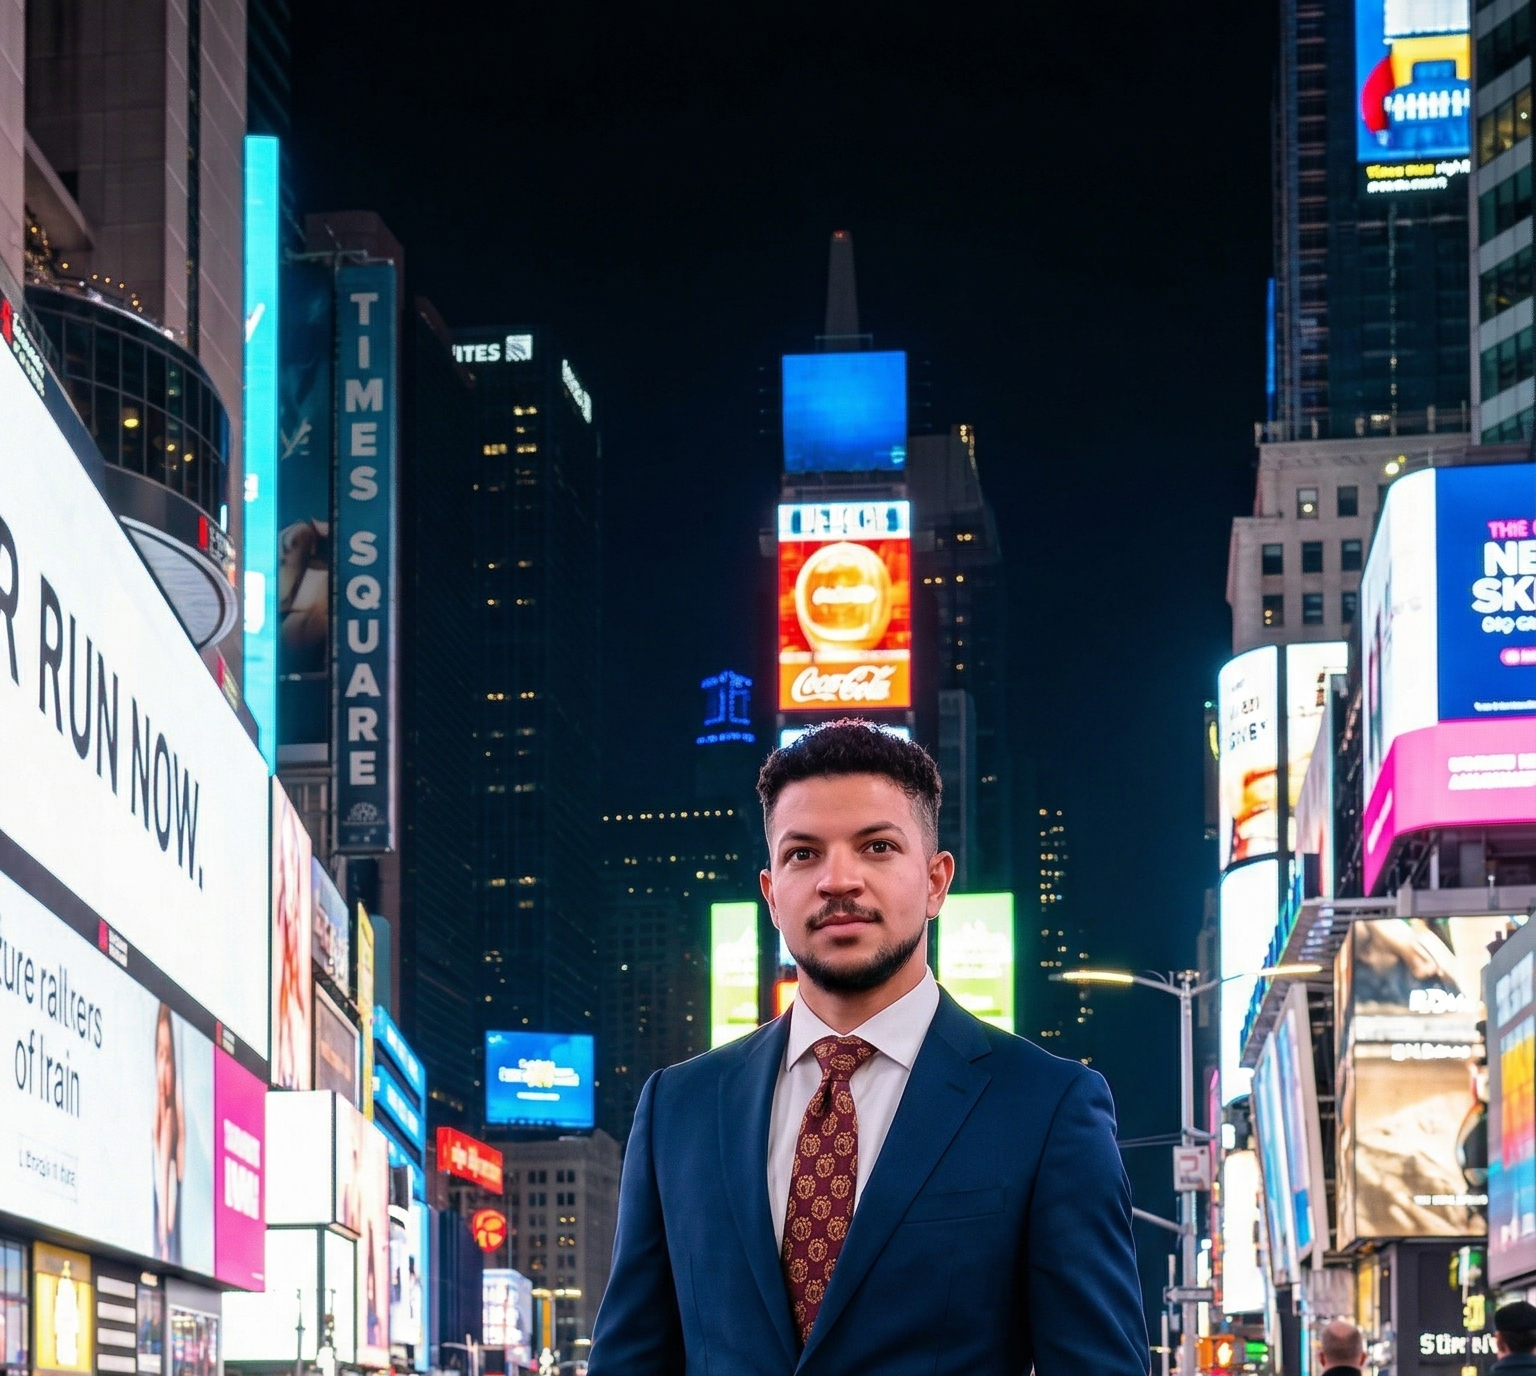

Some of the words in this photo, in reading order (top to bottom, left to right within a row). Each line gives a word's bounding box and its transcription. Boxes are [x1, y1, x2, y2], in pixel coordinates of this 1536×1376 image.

[345, 292, 384, 501] TIMES
[345, 531, 382, 786] SQUARE
[1471, 576, 1536, 614] SK
[39, 572, 119, 798] RUN
[130, 695, 203, 892] NOW.
[0, 936, 35, 1005] ure
[15, 1028, 35, 1094] of
